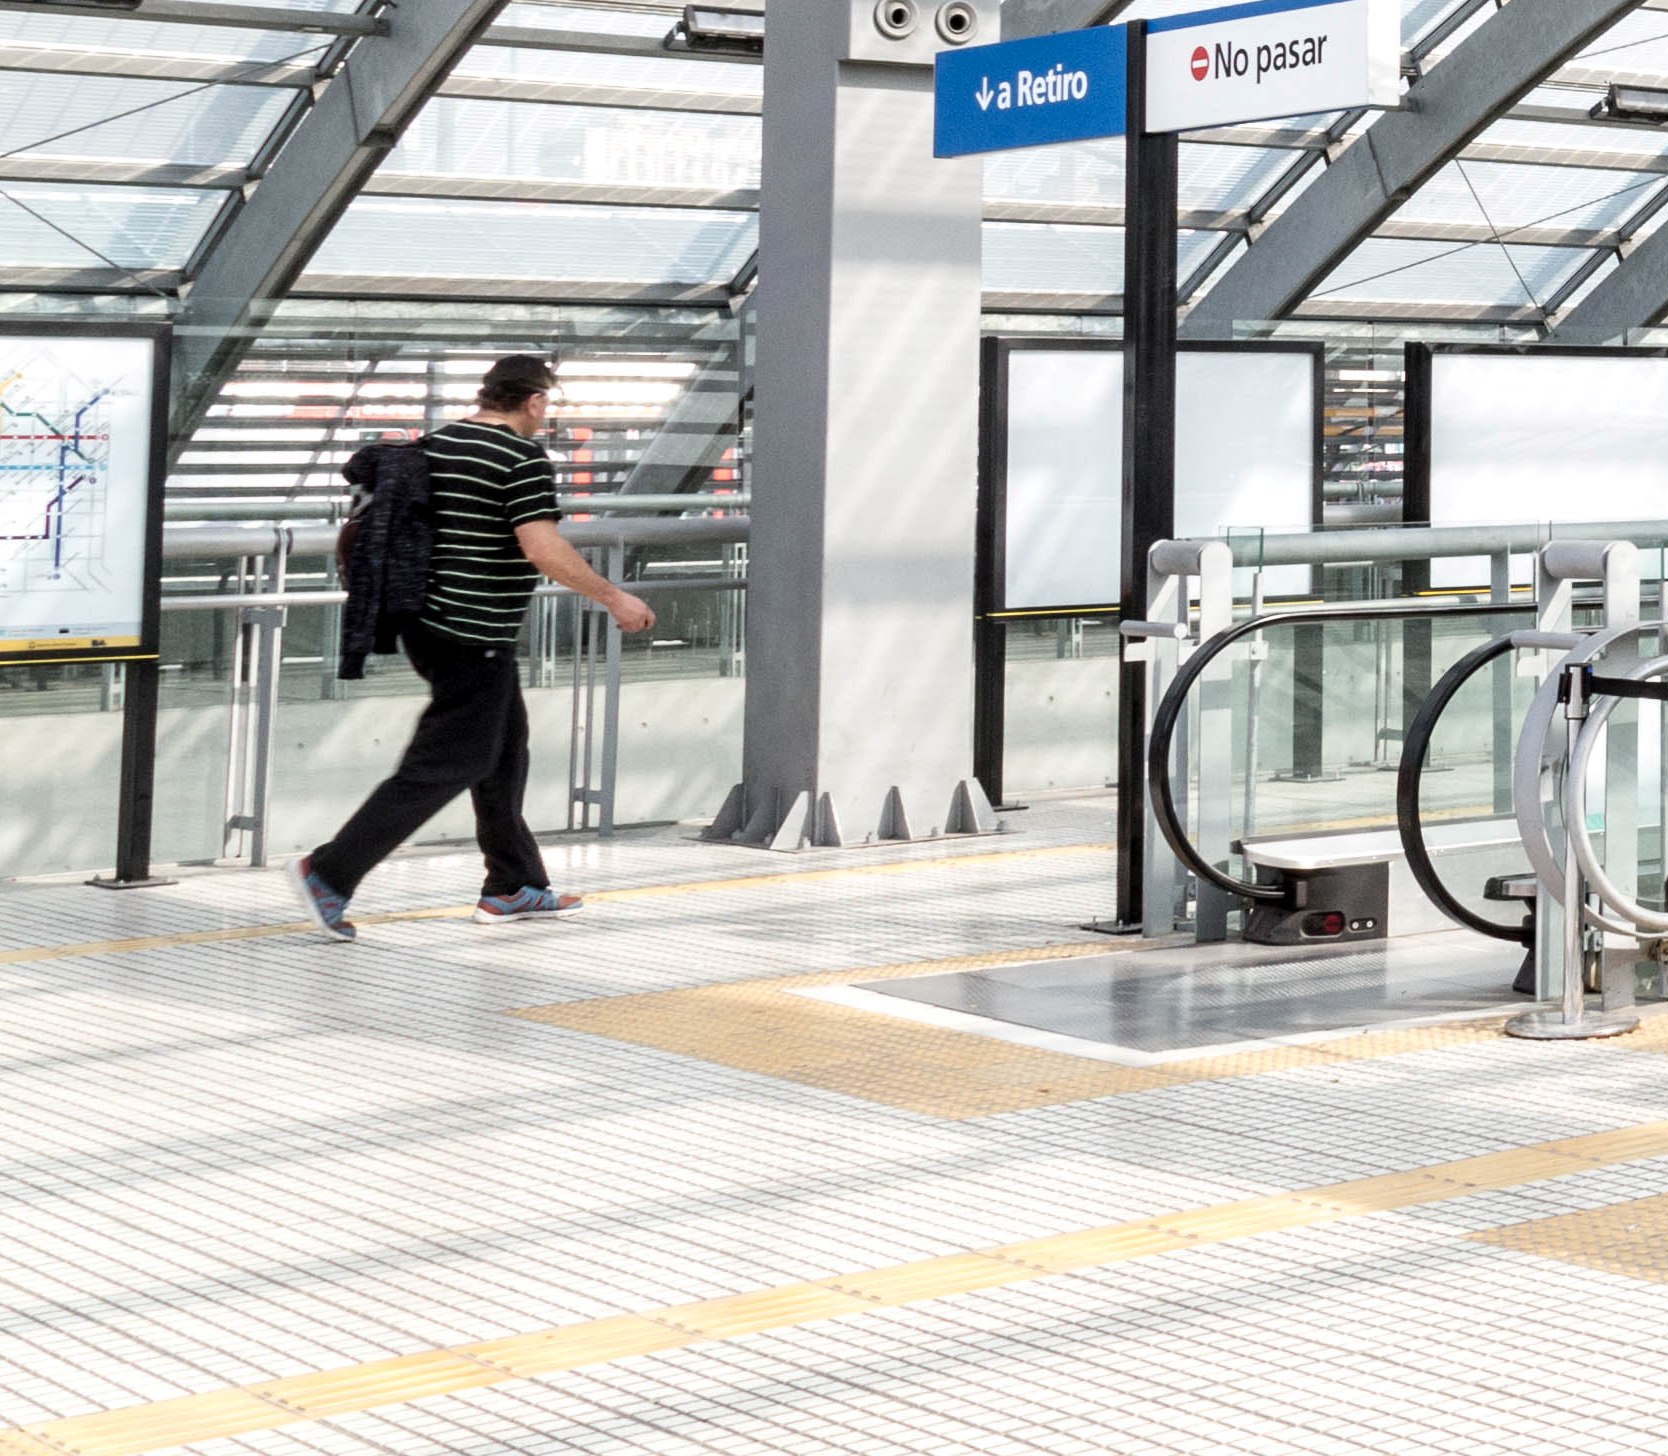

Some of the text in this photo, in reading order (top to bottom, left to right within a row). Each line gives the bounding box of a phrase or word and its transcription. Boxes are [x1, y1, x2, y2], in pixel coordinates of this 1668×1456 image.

[1214, 34, 1328, 84] No pasar
[997, 63, 1088, 109] a Retiro
